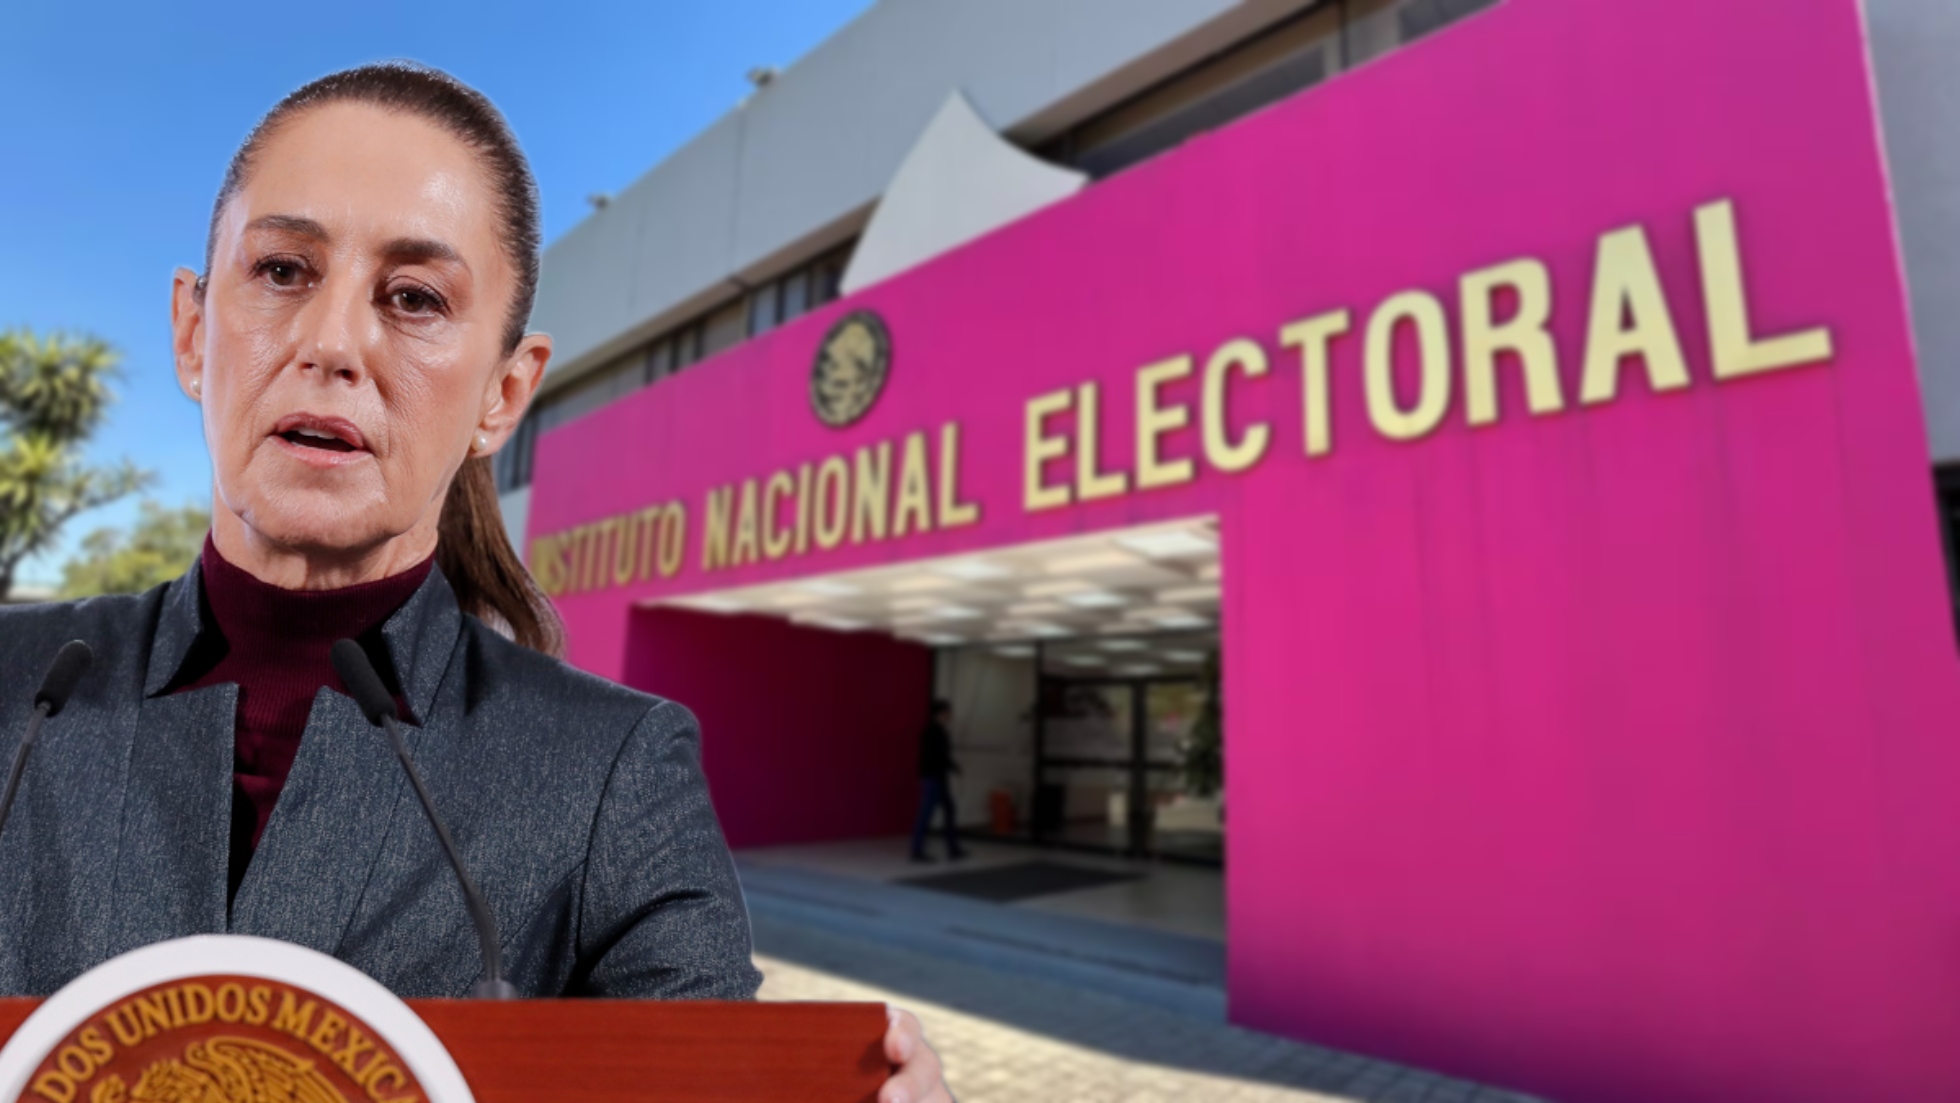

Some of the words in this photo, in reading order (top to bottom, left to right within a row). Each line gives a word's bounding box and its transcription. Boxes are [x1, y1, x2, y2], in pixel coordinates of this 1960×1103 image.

[703, 421, 979, 571] NACIONAL
[1023, 198, 1833, 511] ELECTORAL
[104, 983, 273, 1047] UNIDOS
[271, 991, 419, 1103] MEXIC
